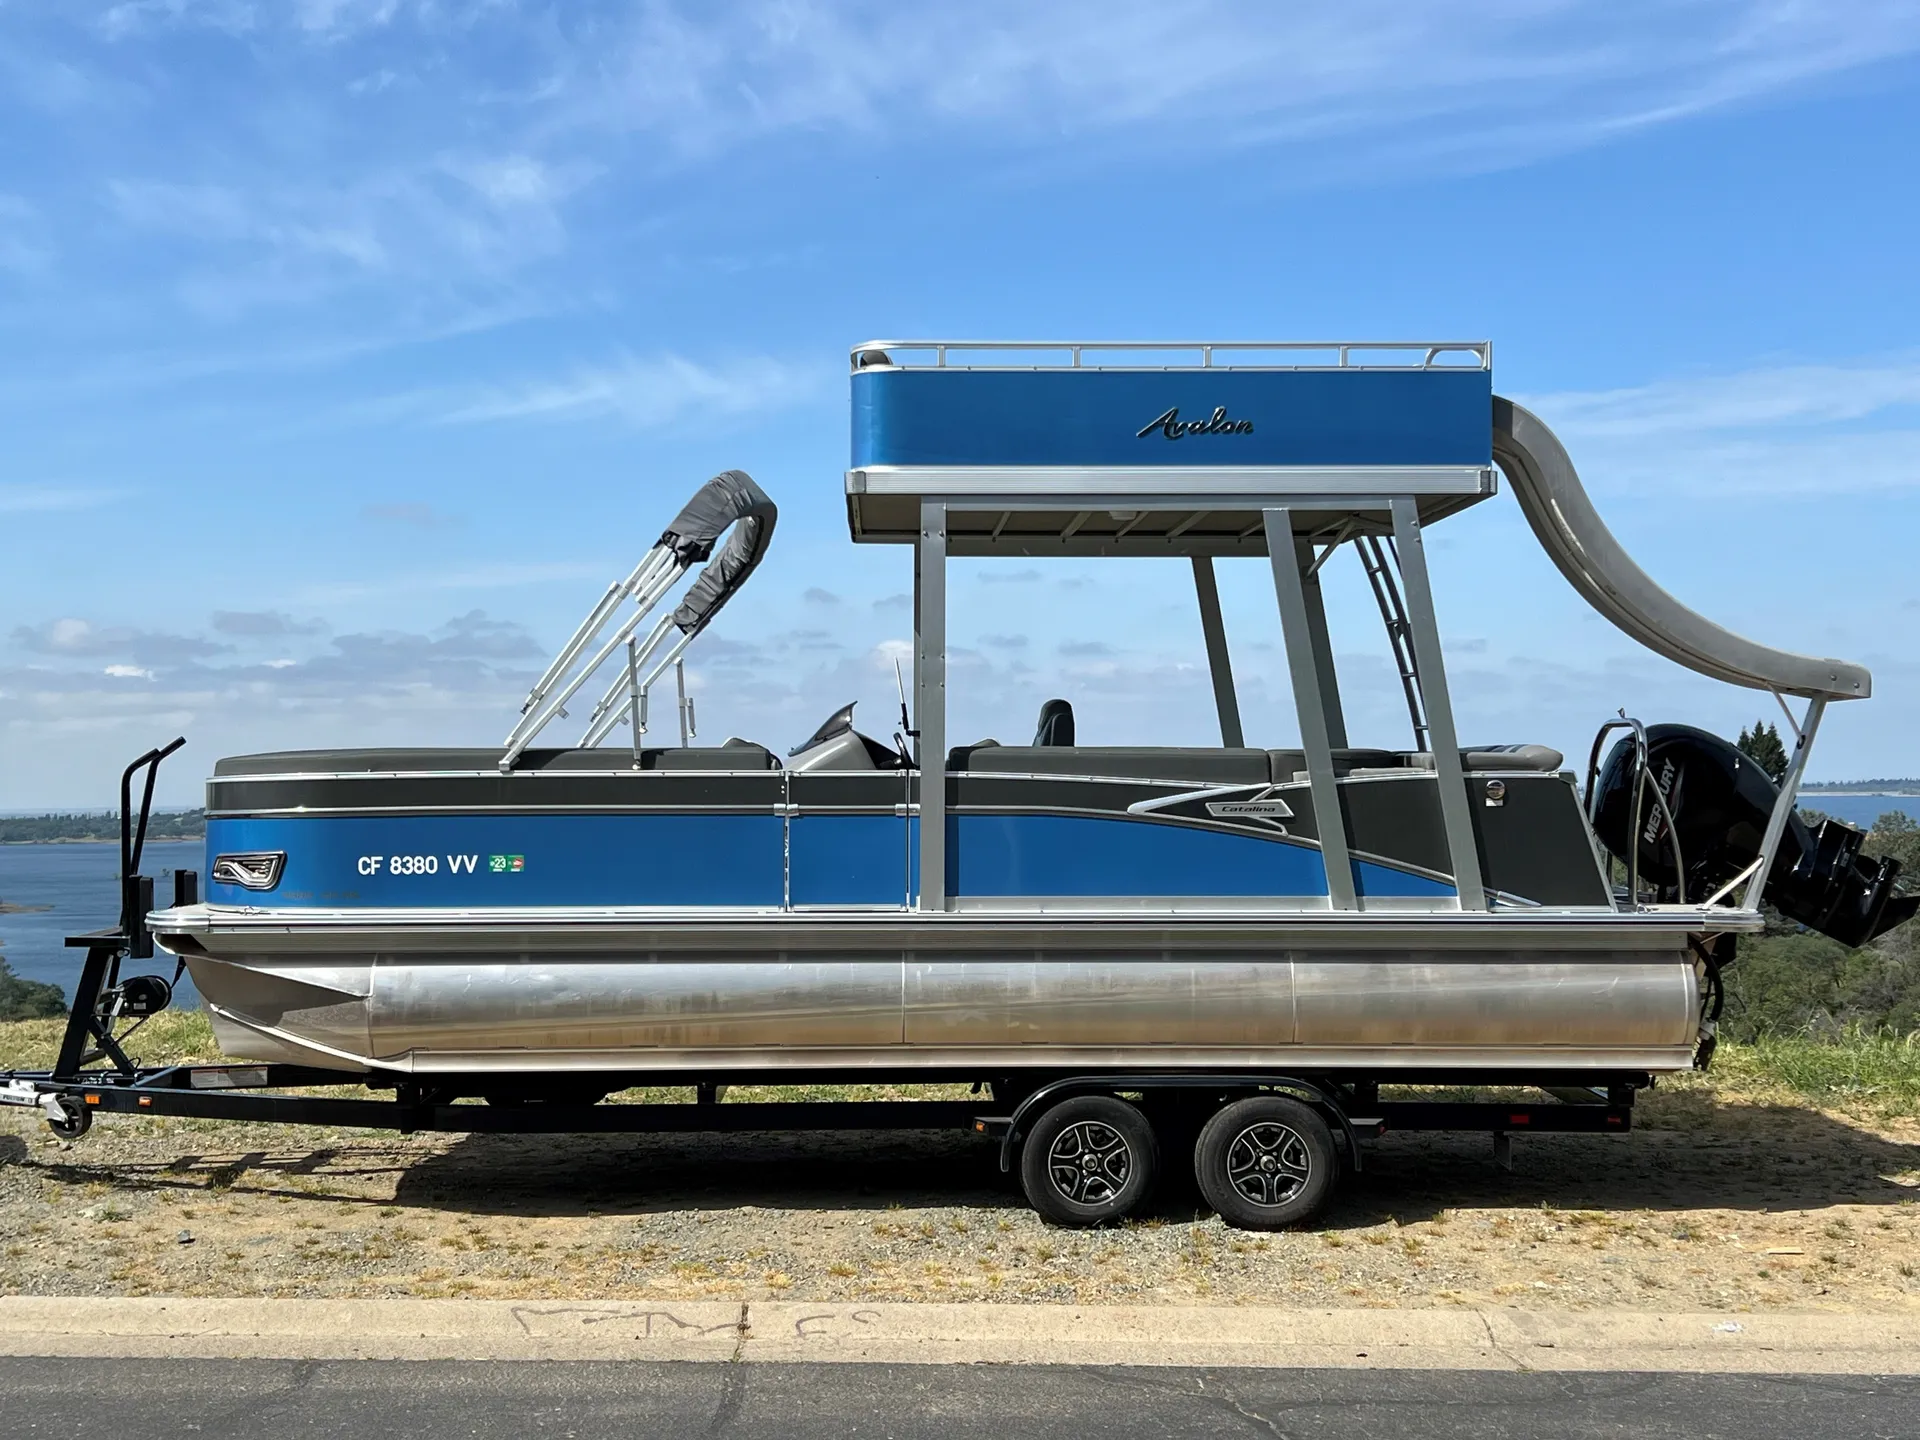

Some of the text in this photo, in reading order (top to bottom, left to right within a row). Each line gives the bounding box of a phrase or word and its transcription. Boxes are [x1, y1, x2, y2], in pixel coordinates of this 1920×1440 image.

[1136, 405, 1254, 440] Avalon
[1643, 757, 1675, 843] MERURY
[357, 854, 479, 875] CF 8380 VV
